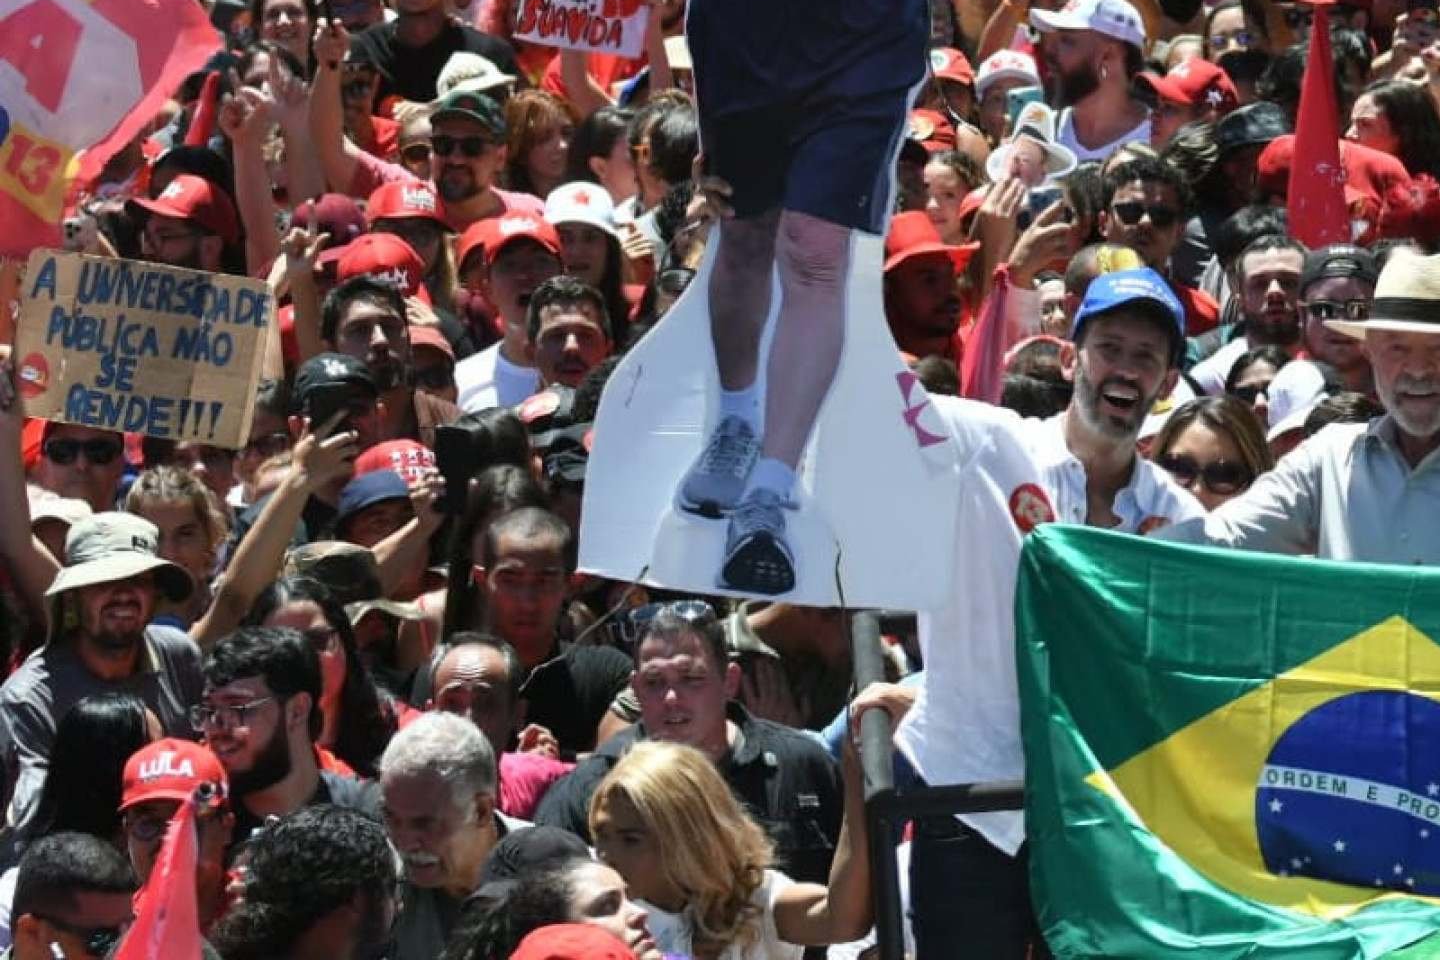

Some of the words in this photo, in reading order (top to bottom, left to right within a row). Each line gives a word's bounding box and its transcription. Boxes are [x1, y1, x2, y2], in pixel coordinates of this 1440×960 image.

[5, 137, 59, 192] 13
[31, 257, 57, 300] A
[47, 304, 159, 357] PÚBLICA
[172, 322, 232, 367] NÃO
[96, 353, 137, 391] SE
[65, 383, 223, 439] RENDE!!!
[139, 751, 194, 779] LULA
[1266, 768, 1348, 796] ORDEM
[1366, 784, 1378, 801] E
